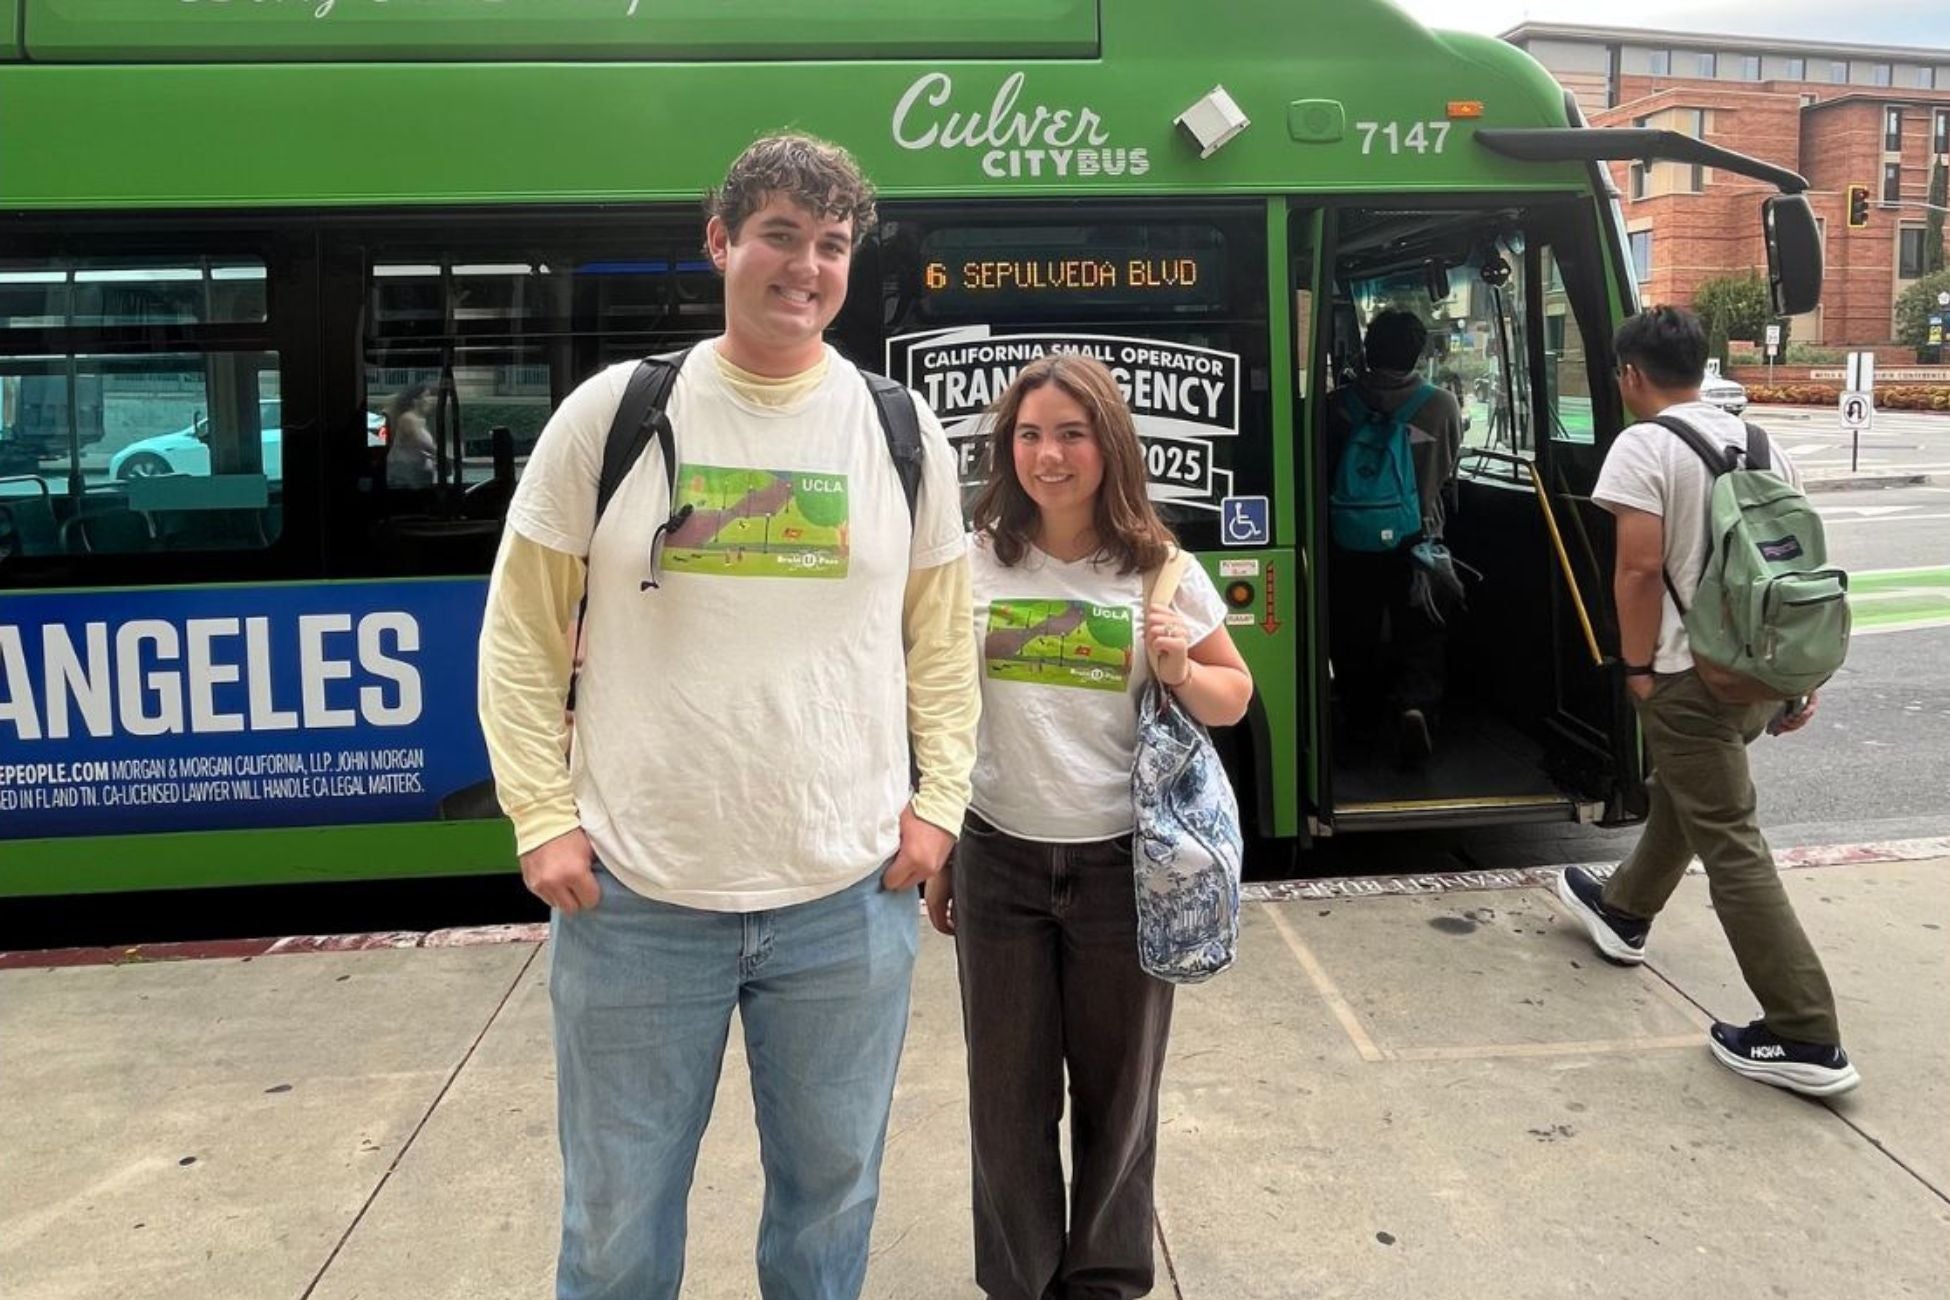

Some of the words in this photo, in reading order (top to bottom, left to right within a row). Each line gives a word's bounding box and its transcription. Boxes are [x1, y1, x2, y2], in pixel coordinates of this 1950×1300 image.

[892, 72, 1109, 149] Culver
[1355, 121, 1452, 155] 7147
[925, 262, 947, 289] 6
[963, 261, 1116, 289] SEPULVEDA
[1129, 259, 1198, 287] BLVD
[924, 344, 1045, 368] CALIFORNIA
[1051, 344, 1115, 362] SMALL
[1121, 347, 1224, 377] OPERATOR
[924, 366, 1016, 412] TRAN
[1111, 367, 1225, 419] GENCY
[802, 479, 844, 493] UCLA
[1093, 607, 1129, 621] UCLA
[0, 611, 423, 740] ANGELES
[112, 759, 166, 780] MORGAN
[168, 758, 177, 778] &
[179, 755, 232, 778] MORGAN
[235, 753, 308, 775] CALIFORNIA,
[336, 751, 368, 772] JOHN
[371, 749, 424, 770] MORGAN
[20, 789, 33, 809] IN
[36, 788, 51, 808] FL
[52, 787, 78, 807] AND
[103, 783, 179, 805] CA-LICENSED
[182, 780, 229, 802] LAWYER
[232, 779, 261, 800] WILL
[263, 777, 310, 799] HANDLE
[313, 776, 329, 797] CA
[331, 775, 366, 796] LEGAL
[369, 772, 425, 794] MATTERS.
[1751, 1044, 1786, 1059] HOKA
